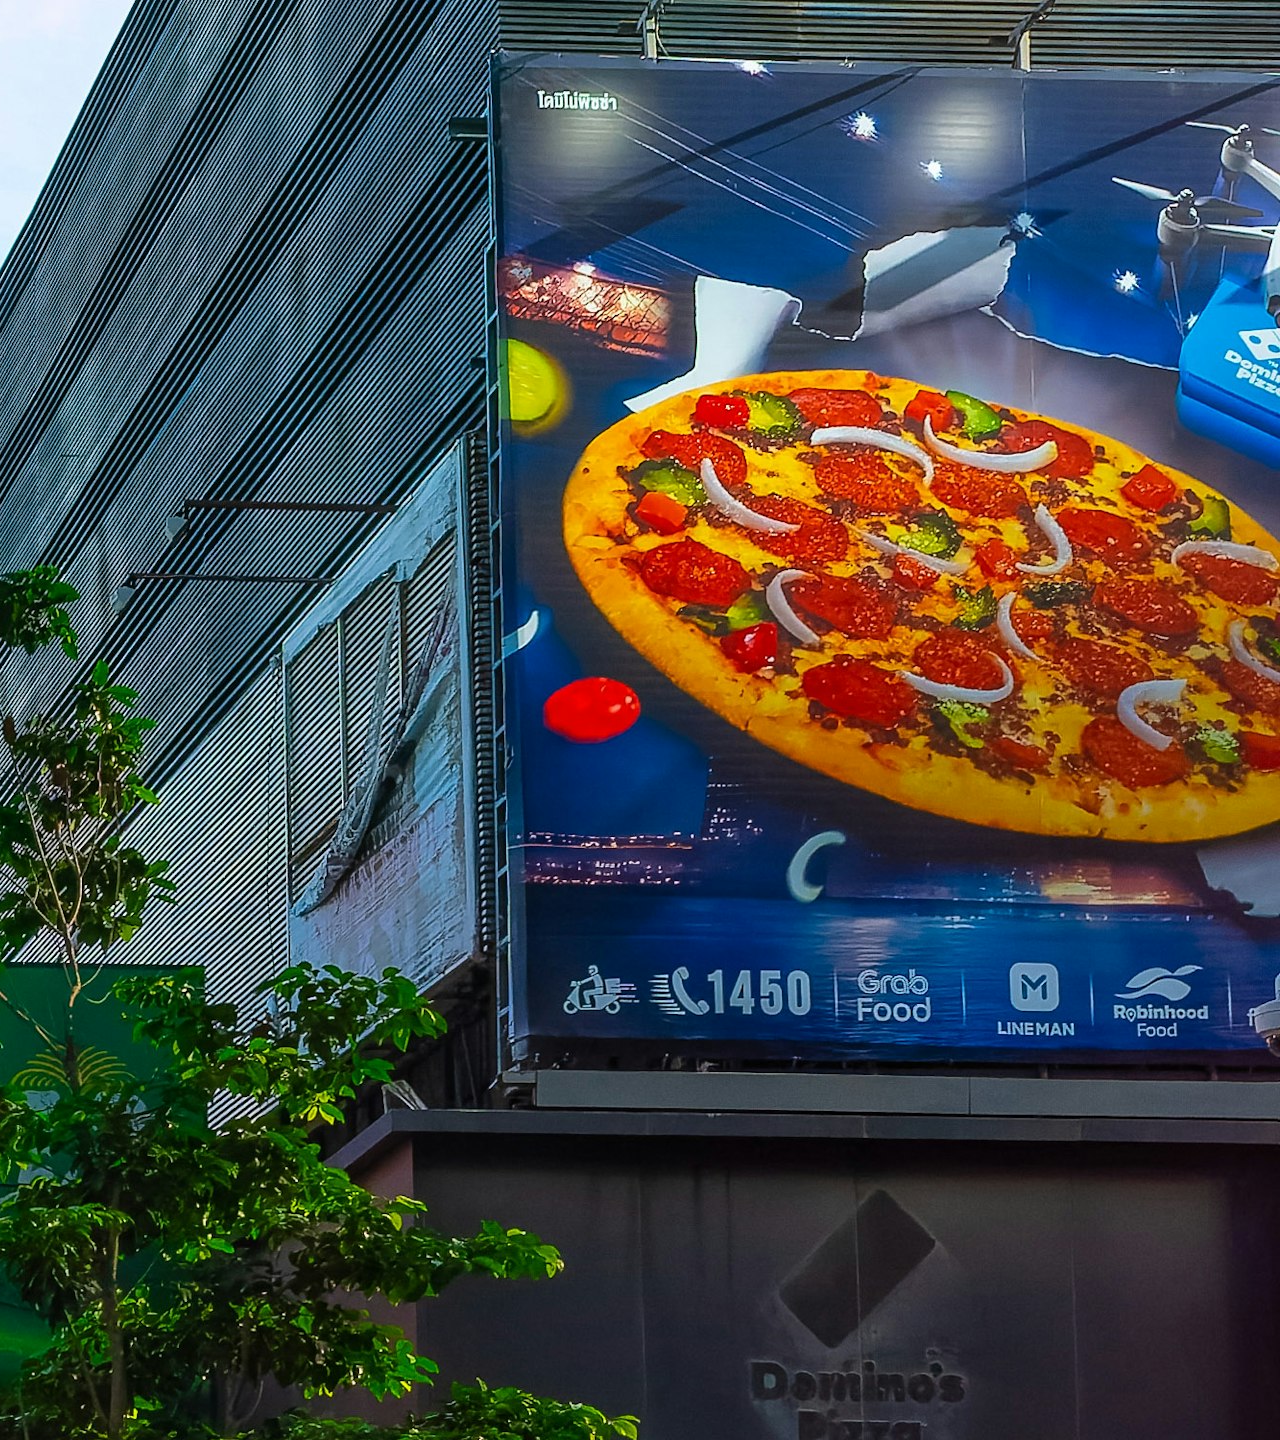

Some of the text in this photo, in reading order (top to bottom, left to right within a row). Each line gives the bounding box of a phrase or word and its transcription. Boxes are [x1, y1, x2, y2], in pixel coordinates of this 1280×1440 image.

[707, 969, 811, 1016] 1450
[857, 968, 929, 994] Grab
[857, 997, 931, 1023] Food
[1137, 1022, 1178, 1037] Food
[749, 1359, 966, 1404] Domino's
